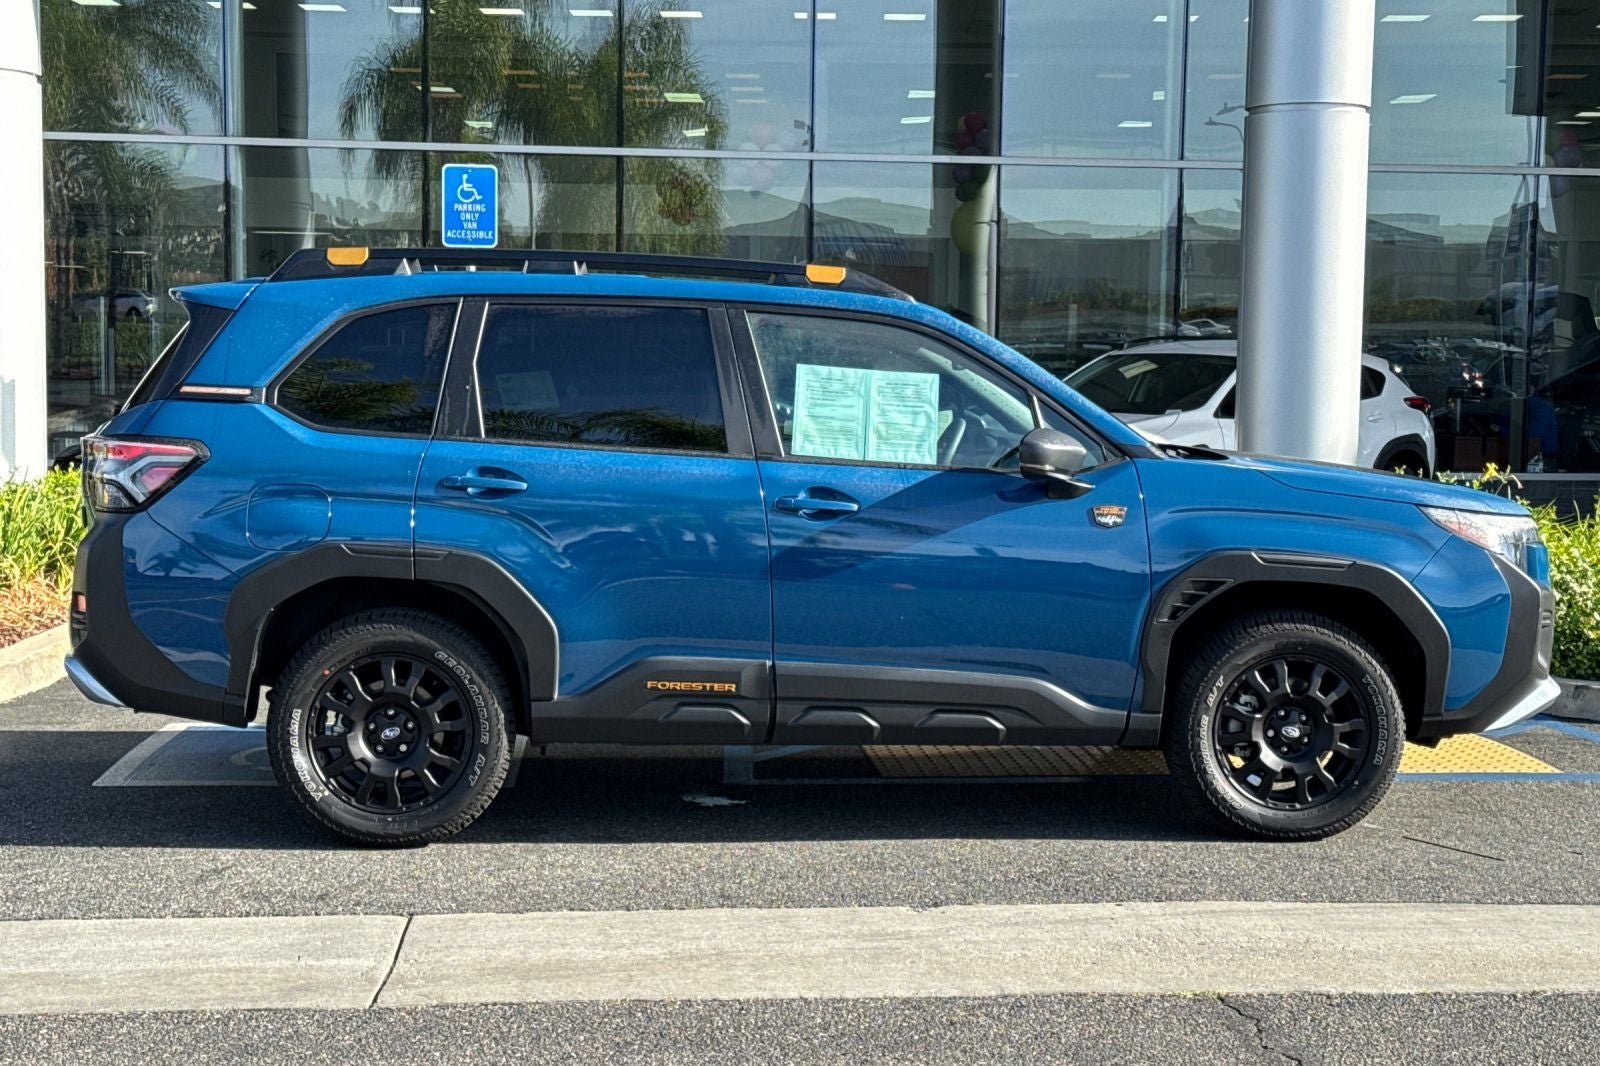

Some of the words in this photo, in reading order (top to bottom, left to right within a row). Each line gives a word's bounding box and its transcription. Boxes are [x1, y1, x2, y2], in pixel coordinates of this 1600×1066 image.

[453, 203, 486, 212] PARKING
[460, 212, 479, 221] ONLY
[462, 221, 478, 229] VAN
[446, 229, 494, 239] ACCESSIBLE
[646, 680, 736, 692] FORESTER
[434, 650, 490, 745] GEOLANDAR
[469, 753, 486, 787] A/T
[1362, 674, 1389, 766] YOKOHAMA
